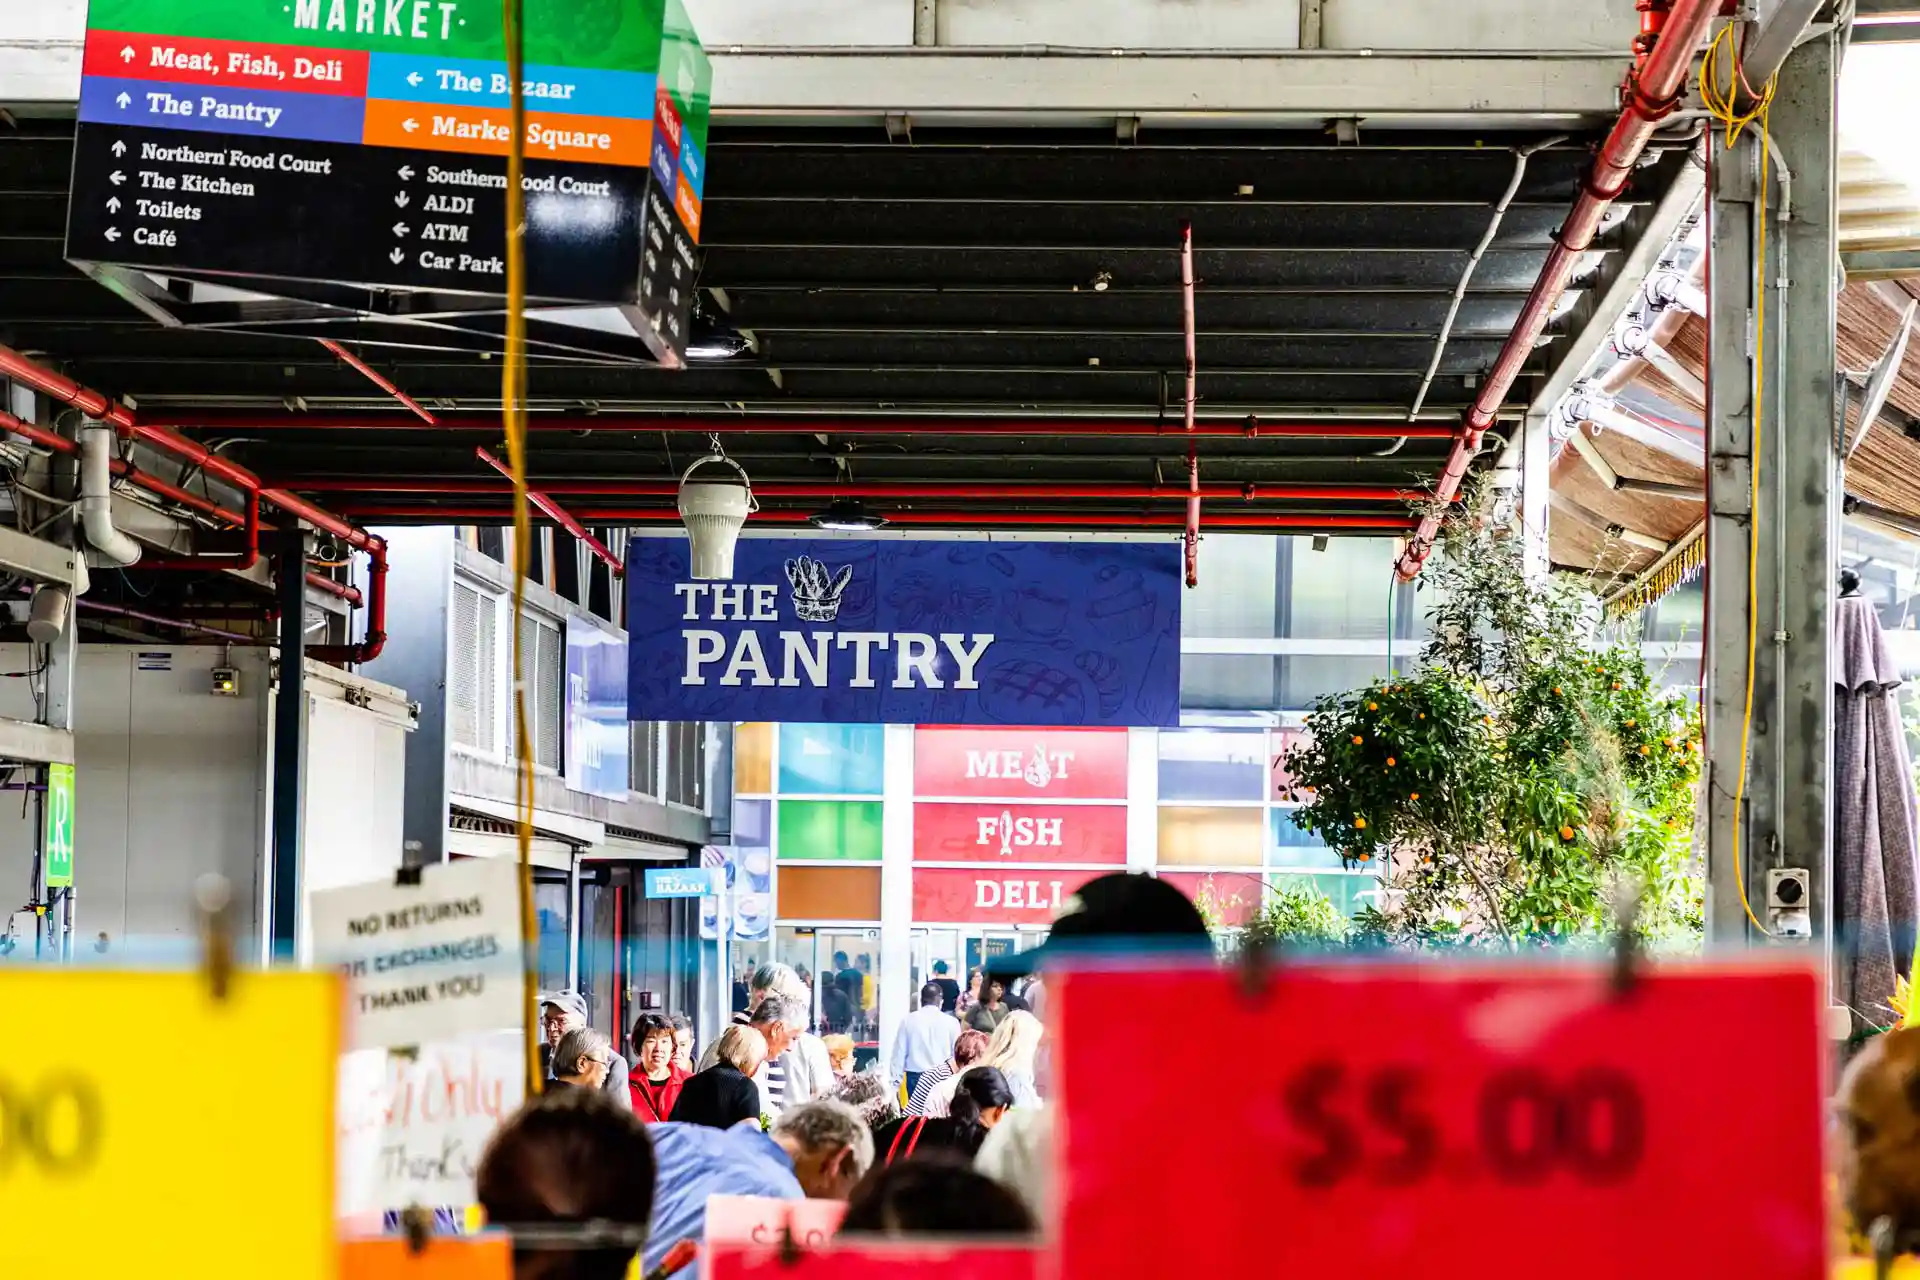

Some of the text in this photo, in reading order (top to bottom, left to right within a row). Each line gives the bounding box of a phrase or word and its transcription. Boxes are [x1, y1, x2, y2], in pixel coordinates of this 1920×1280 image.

[293, 0, 458, 41] MARKET
[150, 46, 343, 82] Meat, Fish, Deli
[435, 69, 482, 94] The
[146, 92, 282, 129] The Pantry
[431, 115, 612, 151] Marke Square
[141, 142, 332, 175] Northern Food Court
[139, 171, 256, 197] The Kitchen
[426, 165, 611, 198] Southern ood Court
[136, 198, 202, 221] Toilets
[423, 194, 475, 215] ALDI
[133, 226, 177, 247] Café
[420, 222, 470, 243] ATM
[419, 250, 504, 275] Car Park
[674, 583, 779, 622] THE
[680, 628, 996, 690] PANTRY
[974, 879, 1065, 909] DELI
[347, 896, 484, 937] NO RETURNS
[373, 934, 501, 973] EXCHANGES
[359, 973, 486, 1014] THANK YOU
